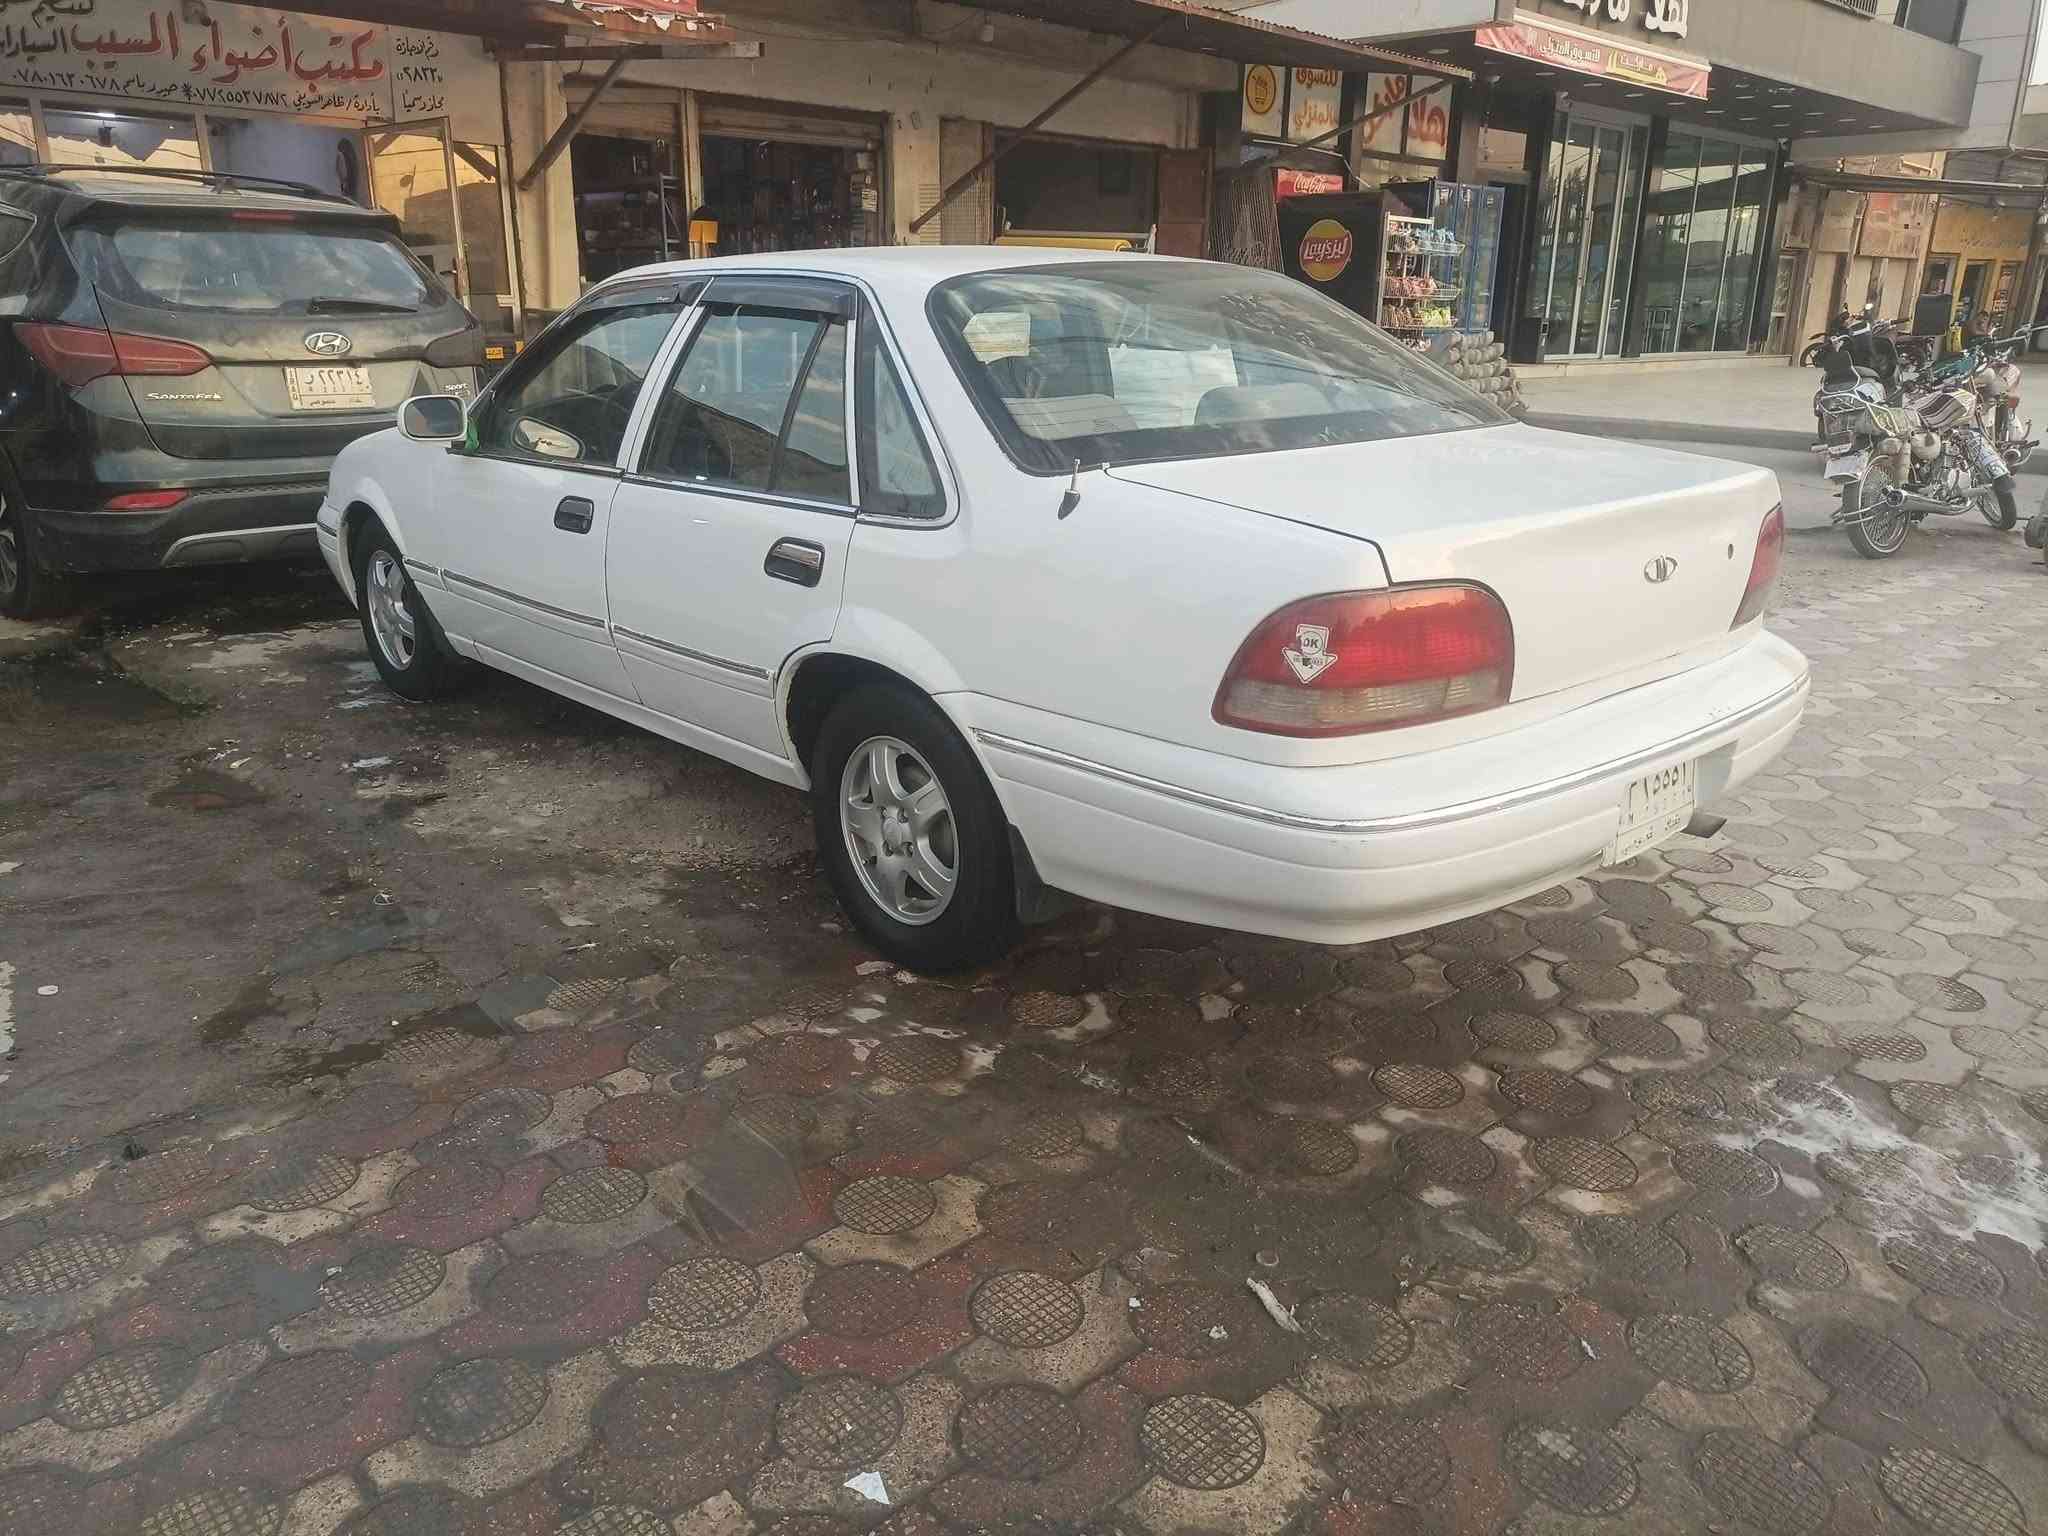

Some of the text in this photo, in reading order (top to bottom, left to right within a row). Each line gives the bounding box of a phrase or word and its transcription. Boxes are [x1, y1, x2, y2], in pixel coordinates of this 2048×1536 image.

[70, 11, 182, 71] المسيب
[188, 16, 294, 84] أضواء
[294, 29, 386, 93] مكتب
